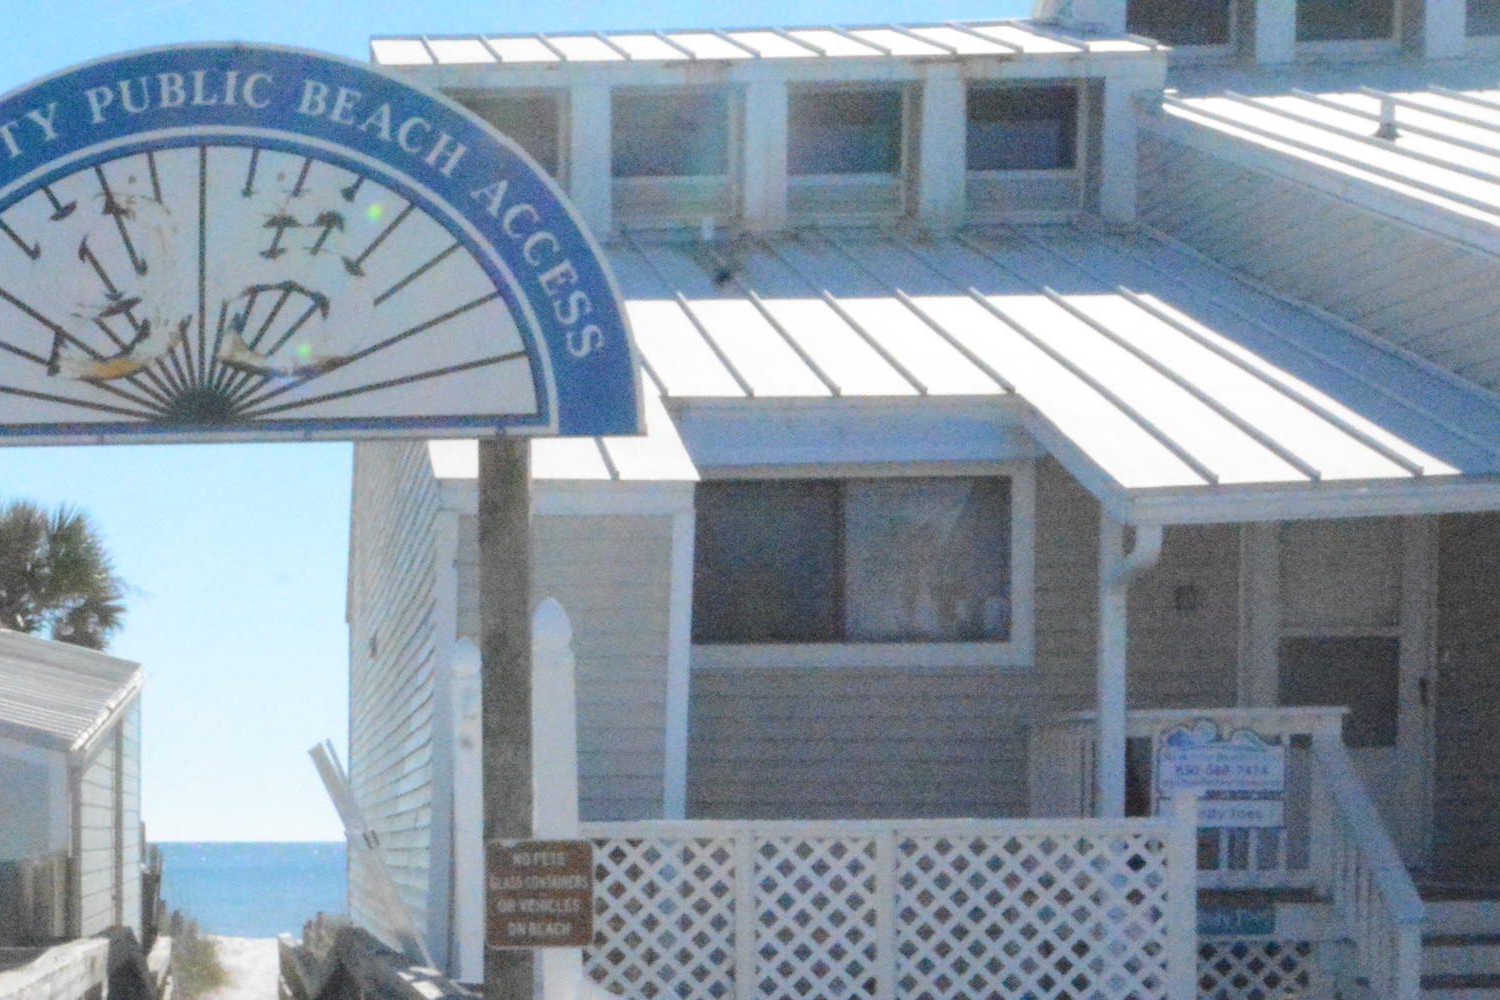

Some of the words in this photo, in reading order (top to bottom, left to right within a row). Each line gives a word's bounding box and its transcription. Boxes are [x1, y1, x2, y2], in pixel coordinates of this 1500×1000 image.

[84, 69, 273, 125] PUBLIC
[297, 79, 467, 177] BEACH
[470, 178, 605, 358] ACCESS
[519, 898, 582, 913] VEHICLES
[529, 921, 571, 937] BEACH
